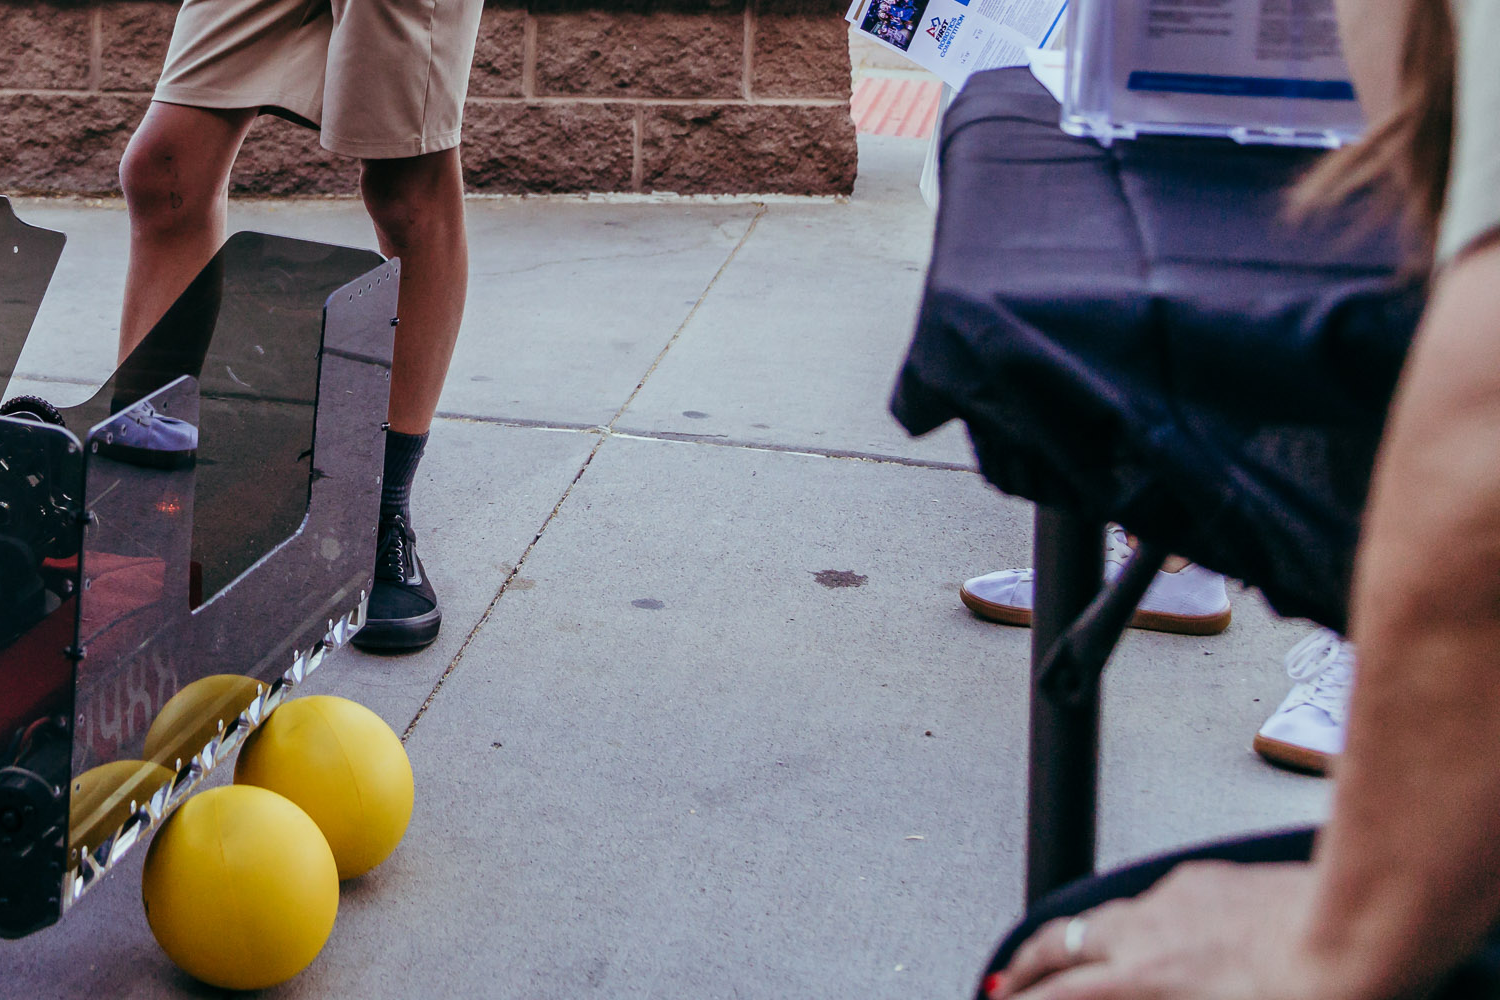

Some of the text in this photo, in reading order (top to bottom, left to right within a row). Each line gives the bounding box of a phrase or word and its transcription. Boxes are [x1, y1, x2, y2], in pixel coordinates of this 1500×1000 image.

[935, 18, 949, 44] FIRST
[937, 16, 957, 51] ROBOTICS
[940, 14, 965, 58] COMPETITION
